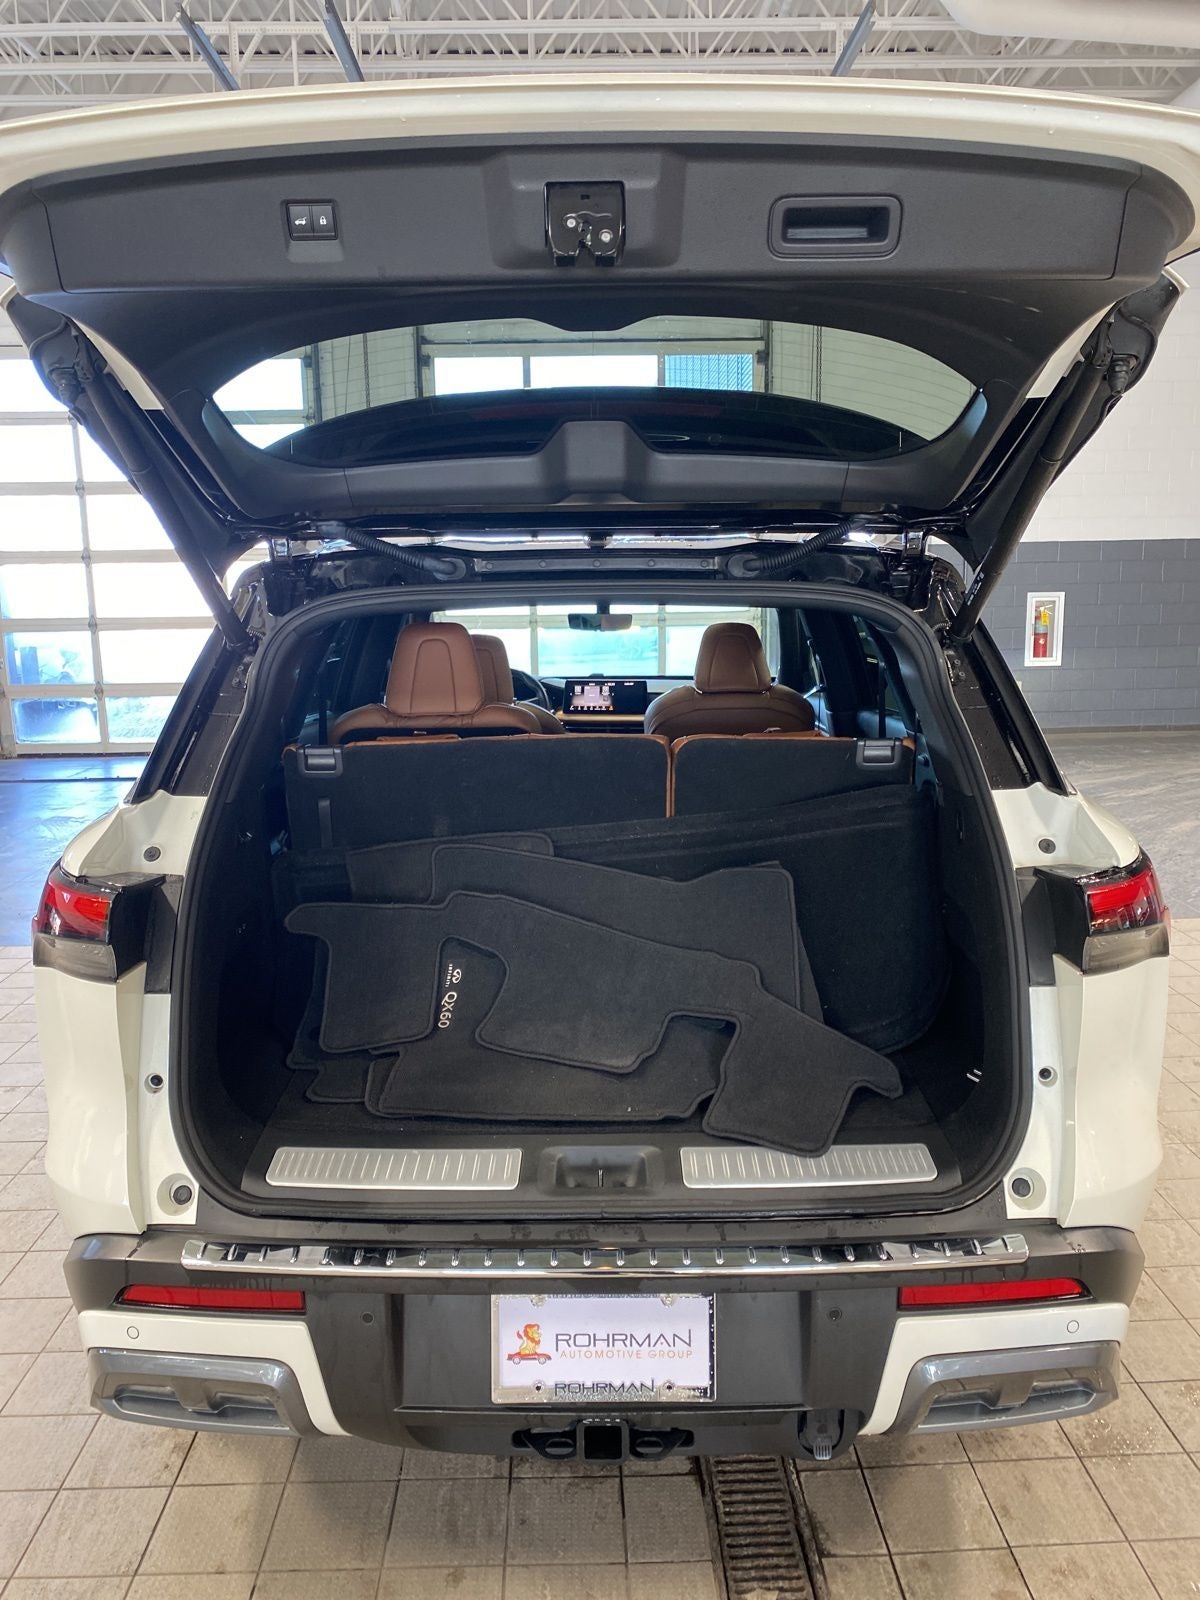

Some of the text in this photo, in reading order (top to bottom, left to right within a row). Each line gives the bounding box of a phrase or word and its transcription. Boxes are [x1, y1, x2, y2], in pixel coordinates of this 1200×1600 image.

[438, 991, 458, 1028] QX60
[555, 1329, 692, 1352] ROHRMAN
[559, 1350, 693, 1359] AUTOMOTIVE GROUP
[554, 1378, 655, 1397] ROHRMAN
